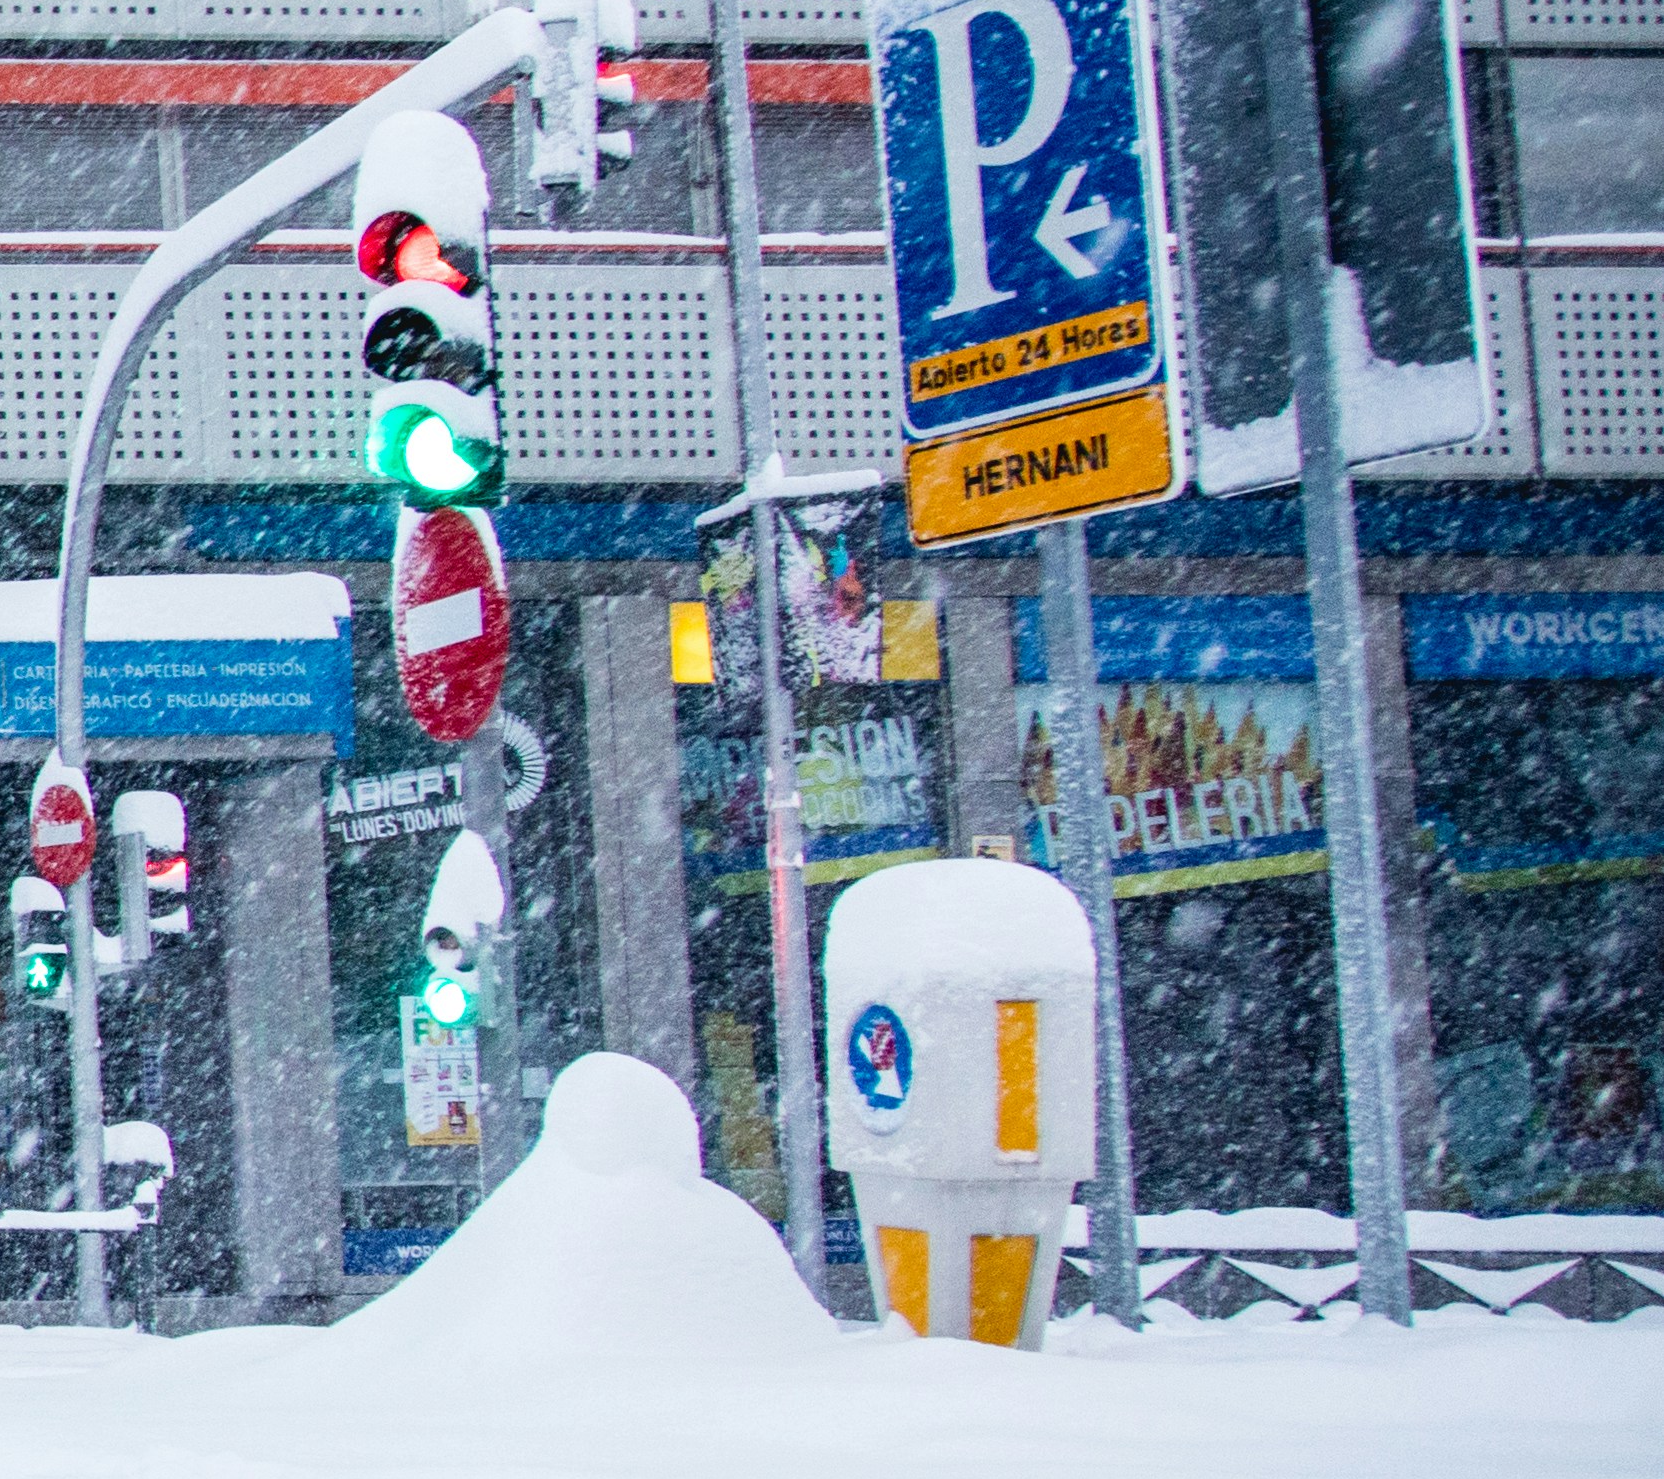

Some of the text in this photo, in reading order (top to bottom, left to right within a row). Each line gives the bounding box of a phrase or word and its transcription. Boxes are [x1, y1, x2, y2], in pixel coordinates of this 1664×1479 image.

[918, 319, 1140, 391] Abierto 24 Horas
[964, 434, 1108, 499] HERNANI
[13, 665, 110, 680] CARTRIA
[329, 763, 462, 817] ABIERT
[342, 803, 466, 842] LUNES DOMIN
[1038, 770, 1310, 868] PPELERIA
[397, 1236, 438, 1258] WOR
